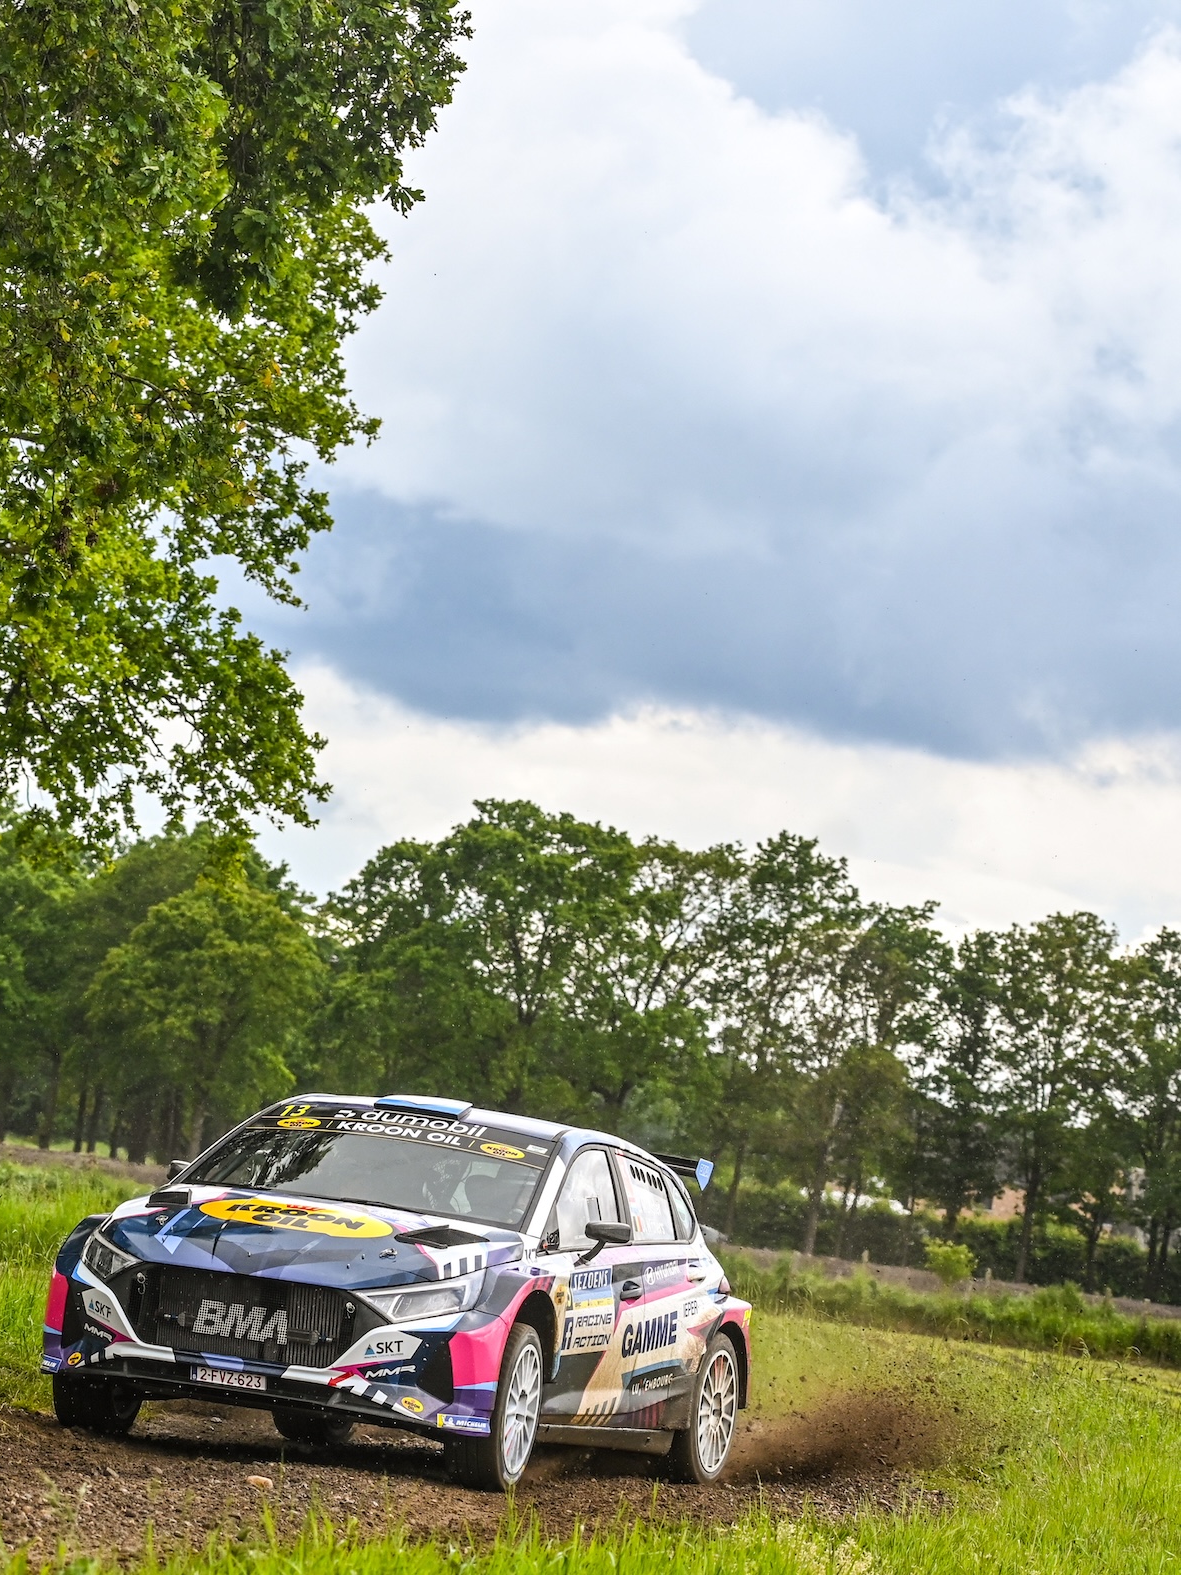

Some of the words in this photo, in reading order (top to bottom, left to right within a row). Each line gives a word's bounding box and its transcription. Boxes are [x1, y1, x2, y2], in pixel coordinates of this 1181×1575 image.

[280, 1104, 311, 1117] 13
[336, 1121, 422, 1138] KROON
[426, 1132, 461, 1146] OIL
[226, 1203, 366, 1230] KROON
[252, 1213, 309, 1229] OIL
[573, 1270, 609, 1291] SEZOENS
[192, 1299, 288, 1345] BMA
[575, 1313, 612, 1328] RACING
[83, 1322, 113, 1342] MMR
[572, 1334, 611, 1348] ACTION
[621, 1310, 678, 1358] GAMME
[375, 1340, 404, 1355] SKT
[364, 1364, 416, 1379] MMR
